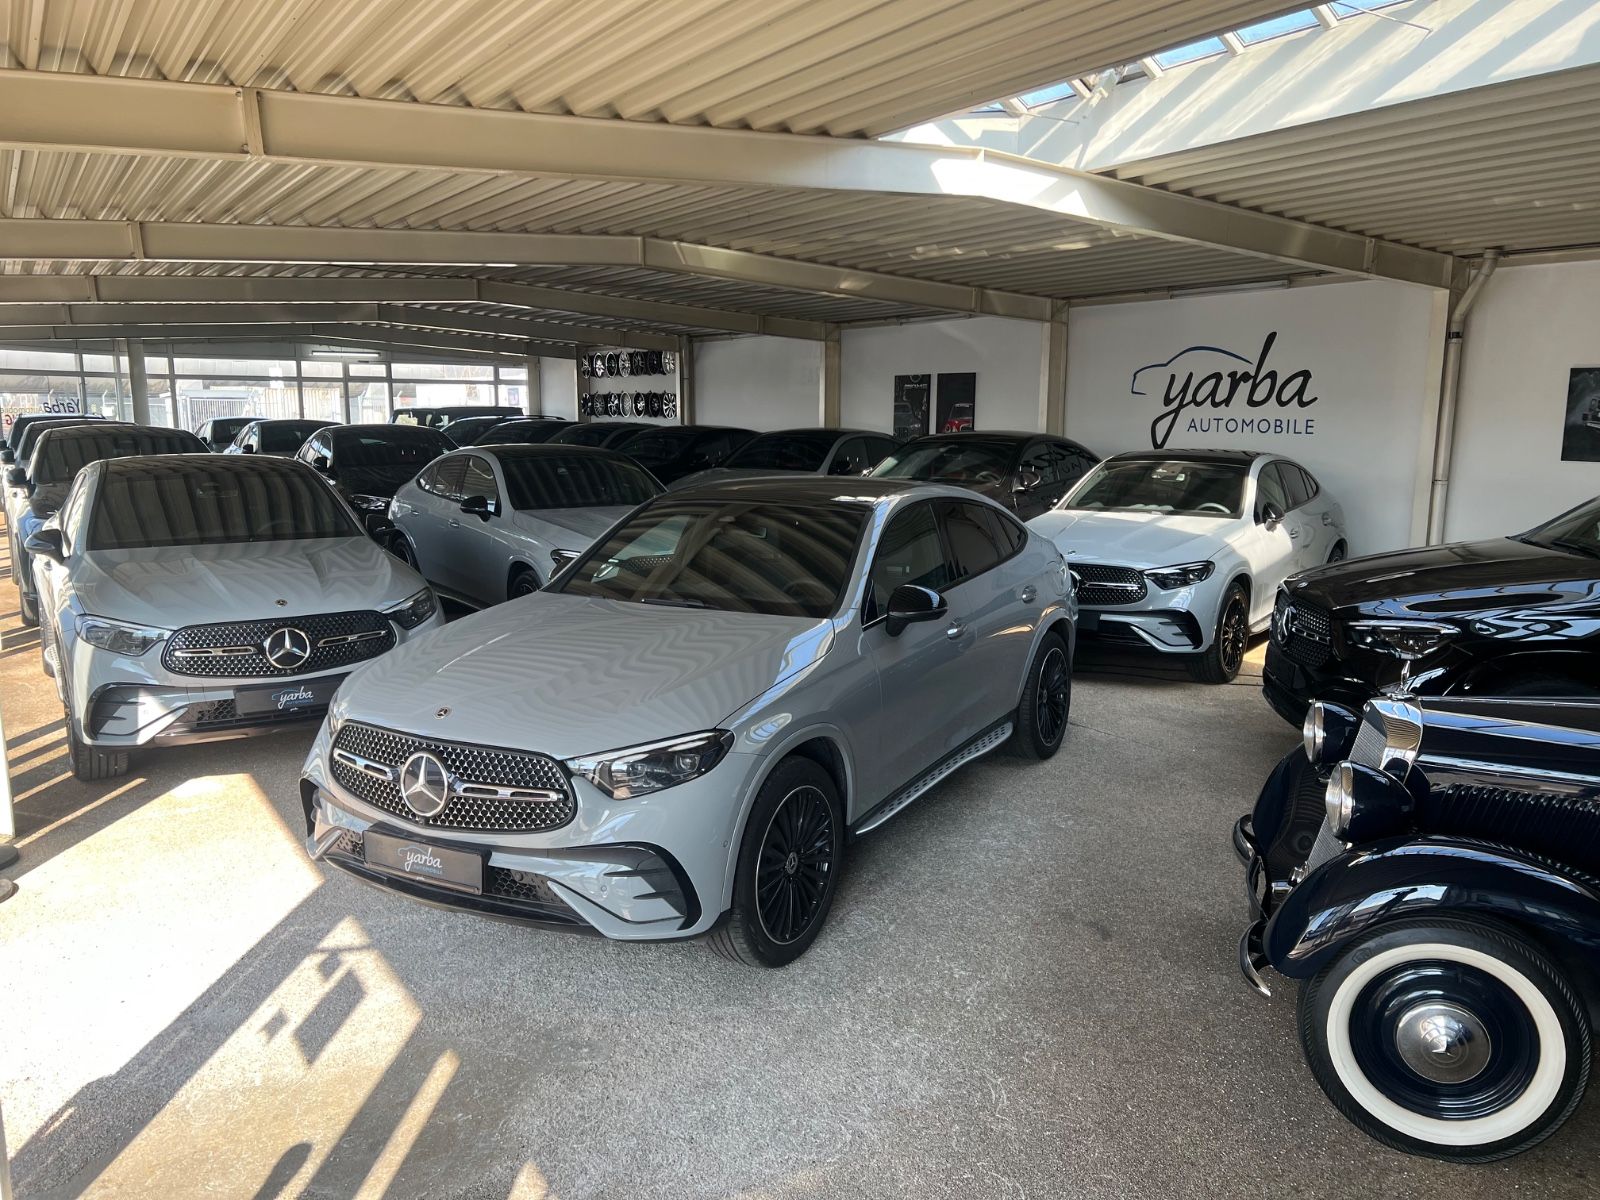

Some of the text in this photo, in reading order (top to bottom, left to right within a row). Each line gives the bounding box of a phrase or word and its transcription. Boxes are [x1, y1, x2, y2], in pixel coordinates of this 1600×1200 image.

[1151, 331, 1318, 449] yarba
[1187, 418, 1314, 434] AUTOMOBILE
[278, 686, 313, 709] yarba
[405, 848, 442, 872] yarba
